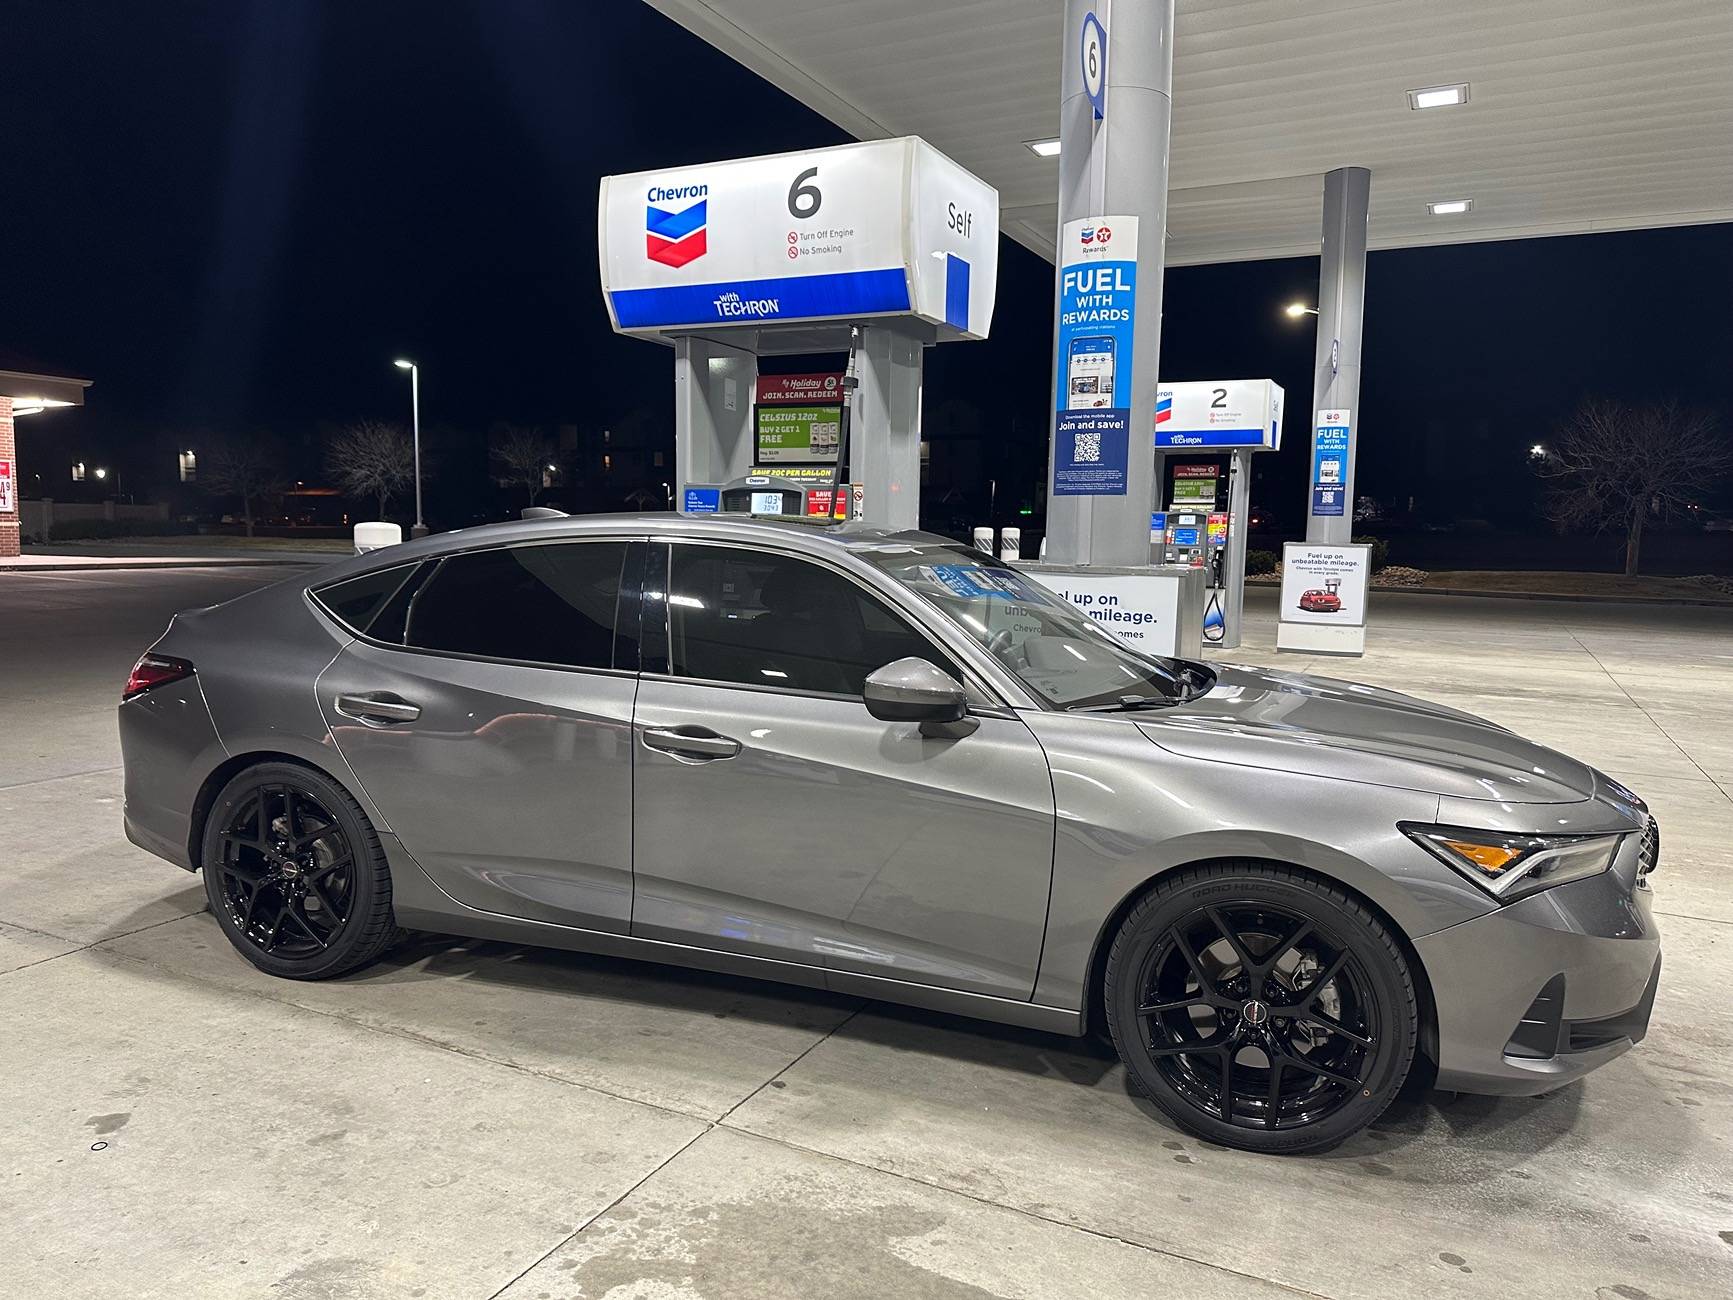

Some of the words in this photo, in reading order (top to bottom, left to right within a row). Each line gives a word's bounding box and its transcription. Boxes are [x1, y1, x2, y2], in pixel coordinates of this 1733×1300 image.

[1089, 41, 1096, 78] 6
[647, 184, 708, 202] Chevron
[788, 166, 822, 219] 6
[948, 202, 972, 239] Self
[799, 231, 815, 241] Turn
[817, 230, 828, 240] Off
[830, 228, 854, 240] Engine
[800, 247, 810, 256] No
[811, 244, 842, 256] Smoking
[1082, 246, 1107, 254] Rewards
[1064, 268, 1130, 296] FUEL
[719, 292, 740, 303] with
[1076, 294, 1113, 308] WITH
[714, 298, 779, 317] TECHRON
[1062, 310, 1130, 326] REWARDS
[790, 378, 822, 390] Holiday
[1210, 388, 1228, 408] 2
[1059, 421, 1075, 430] Join
[1078, 420, 1095, 429] and
[1097, 420, 1124, 429] save!
[760, 435, 783, 443] FREE
[1318, 429, 1347, 438] FUEL
[1074, 594, 1093, 605] up
[1098, 595, 1118, 606] on
[1088, 608, 1158, 625] mileage.
[1013, 624, 1041, 634] Chevro
